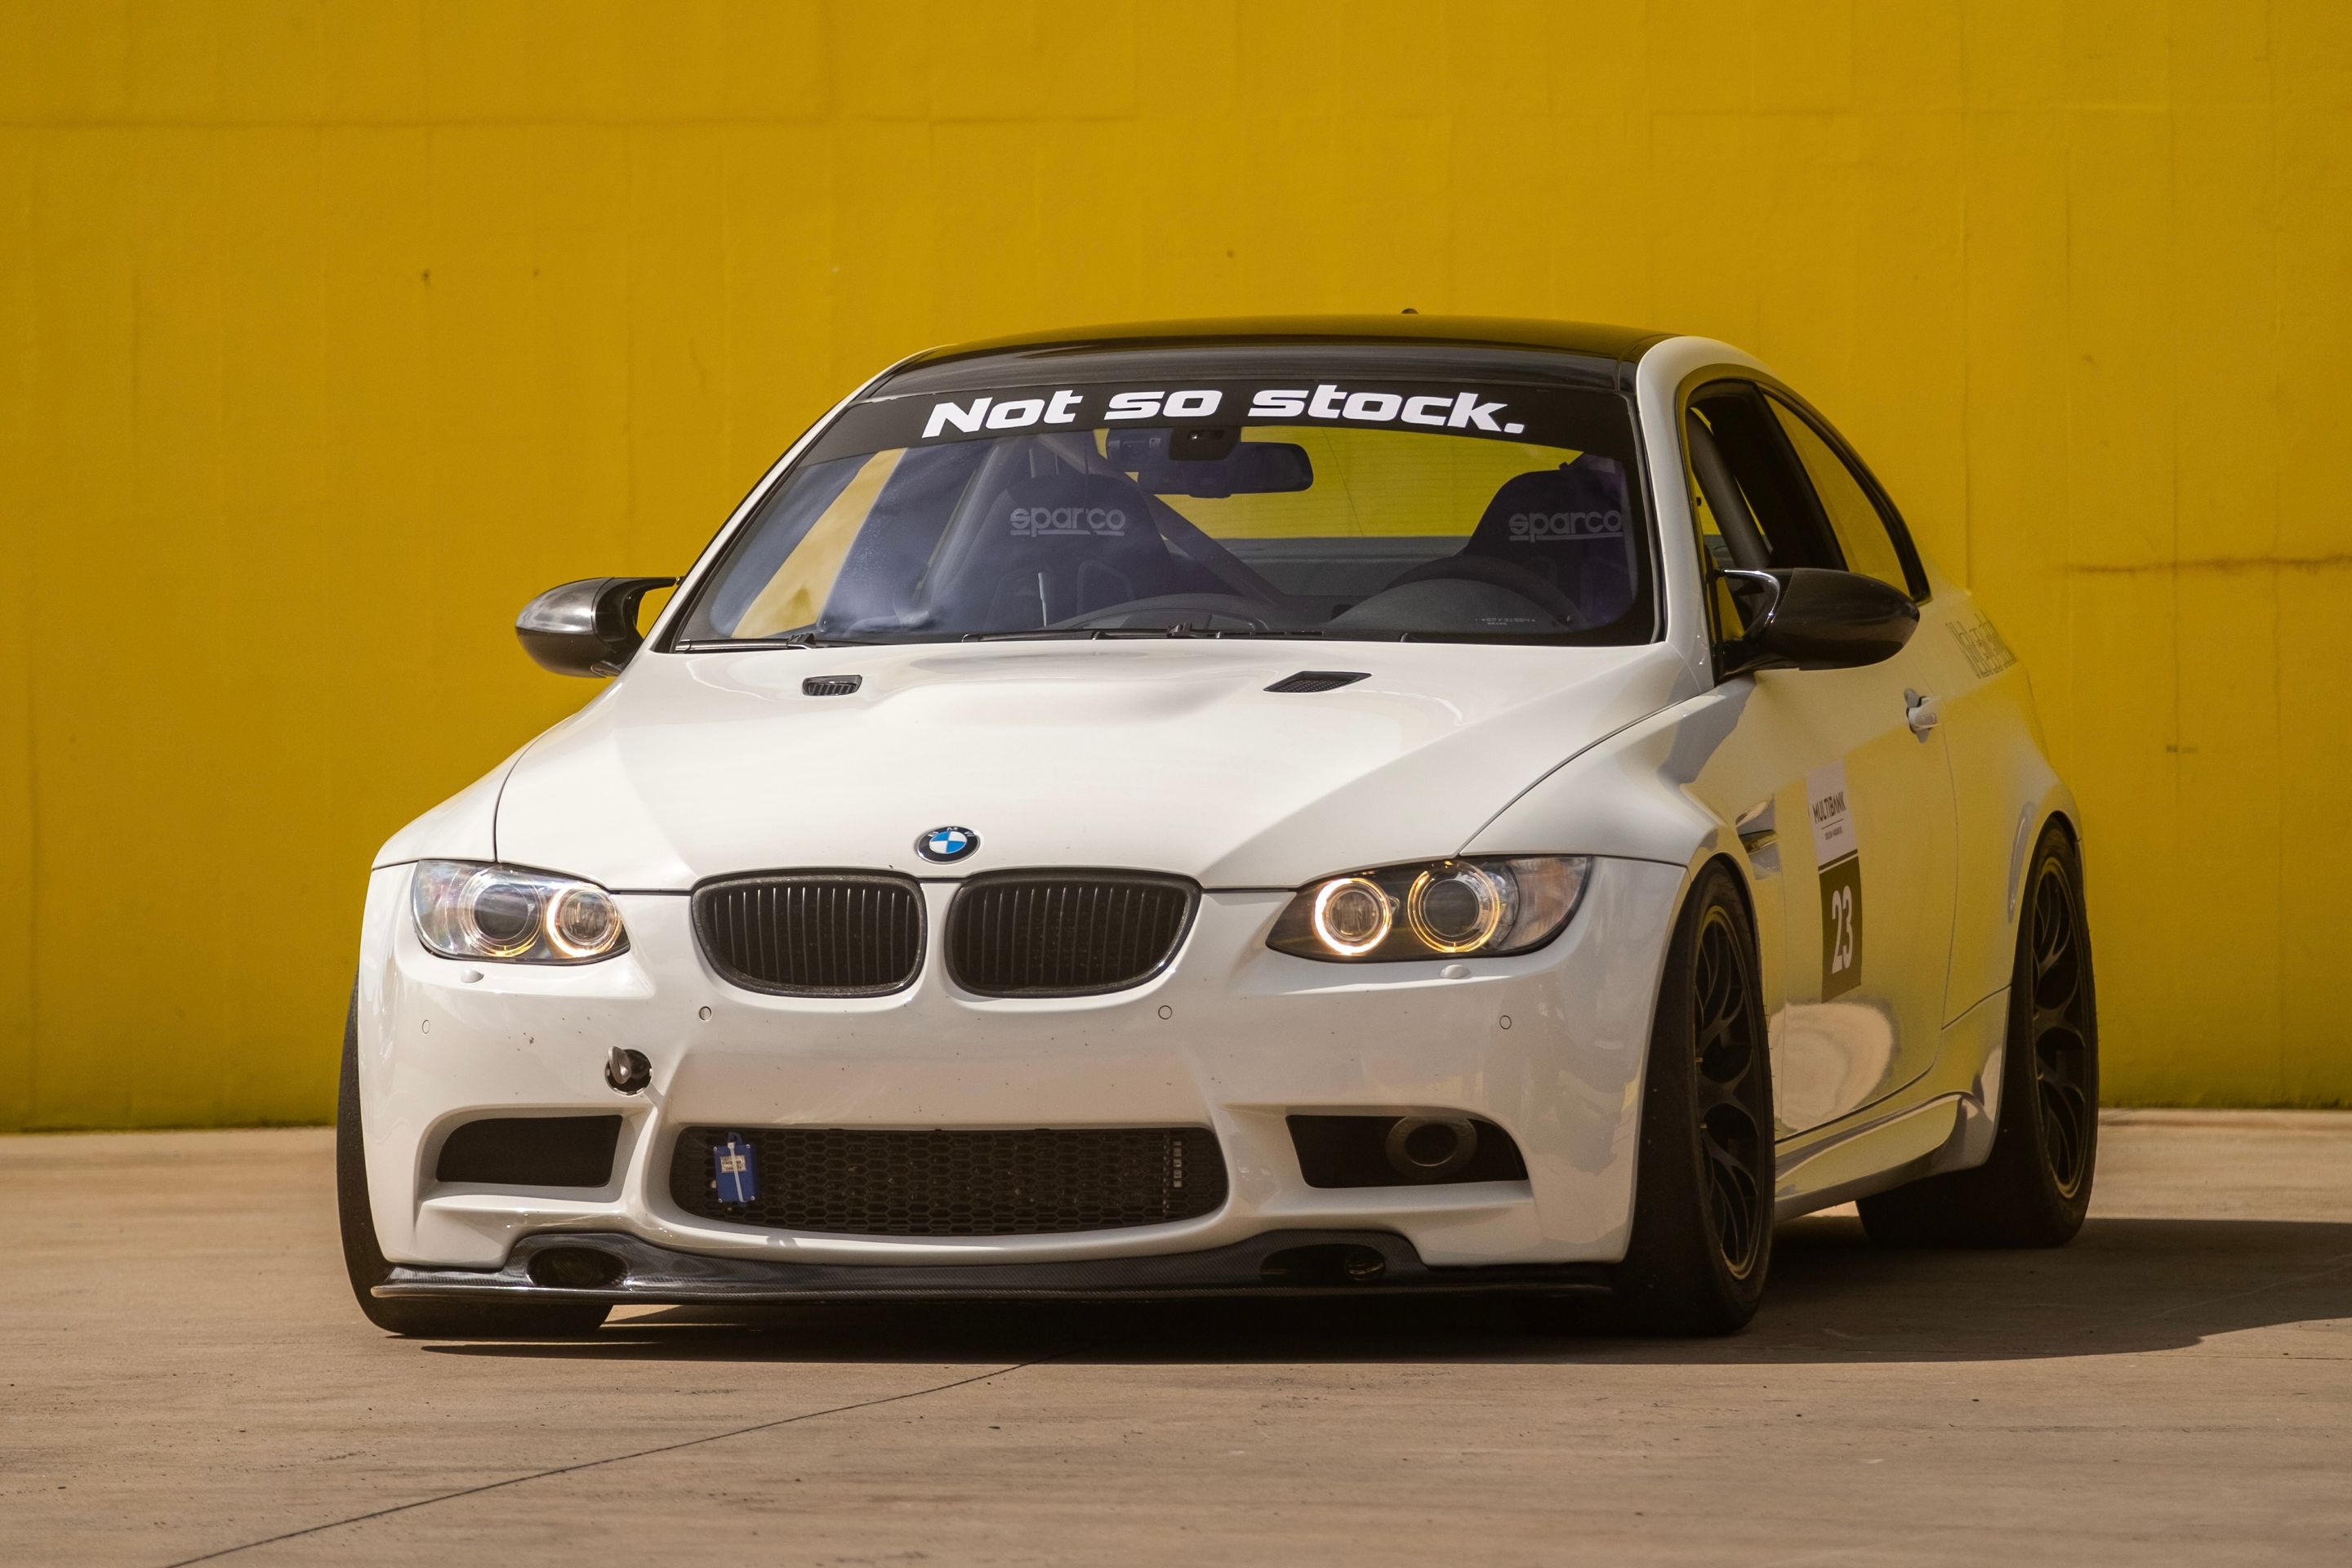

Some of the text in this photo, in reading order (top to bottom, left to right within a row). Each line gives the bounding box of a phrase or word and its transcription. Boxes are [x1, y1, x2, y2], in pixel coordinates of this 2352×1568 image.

[921, 385, 1525, 439] Not so stock.
[1009, 507, 1126, 538] sparco
[1508, 510, 1623, 543] sparco
[1812, 791, 1846, 824] MULTIBANK
[1831, 884, 1853, 974] 23
